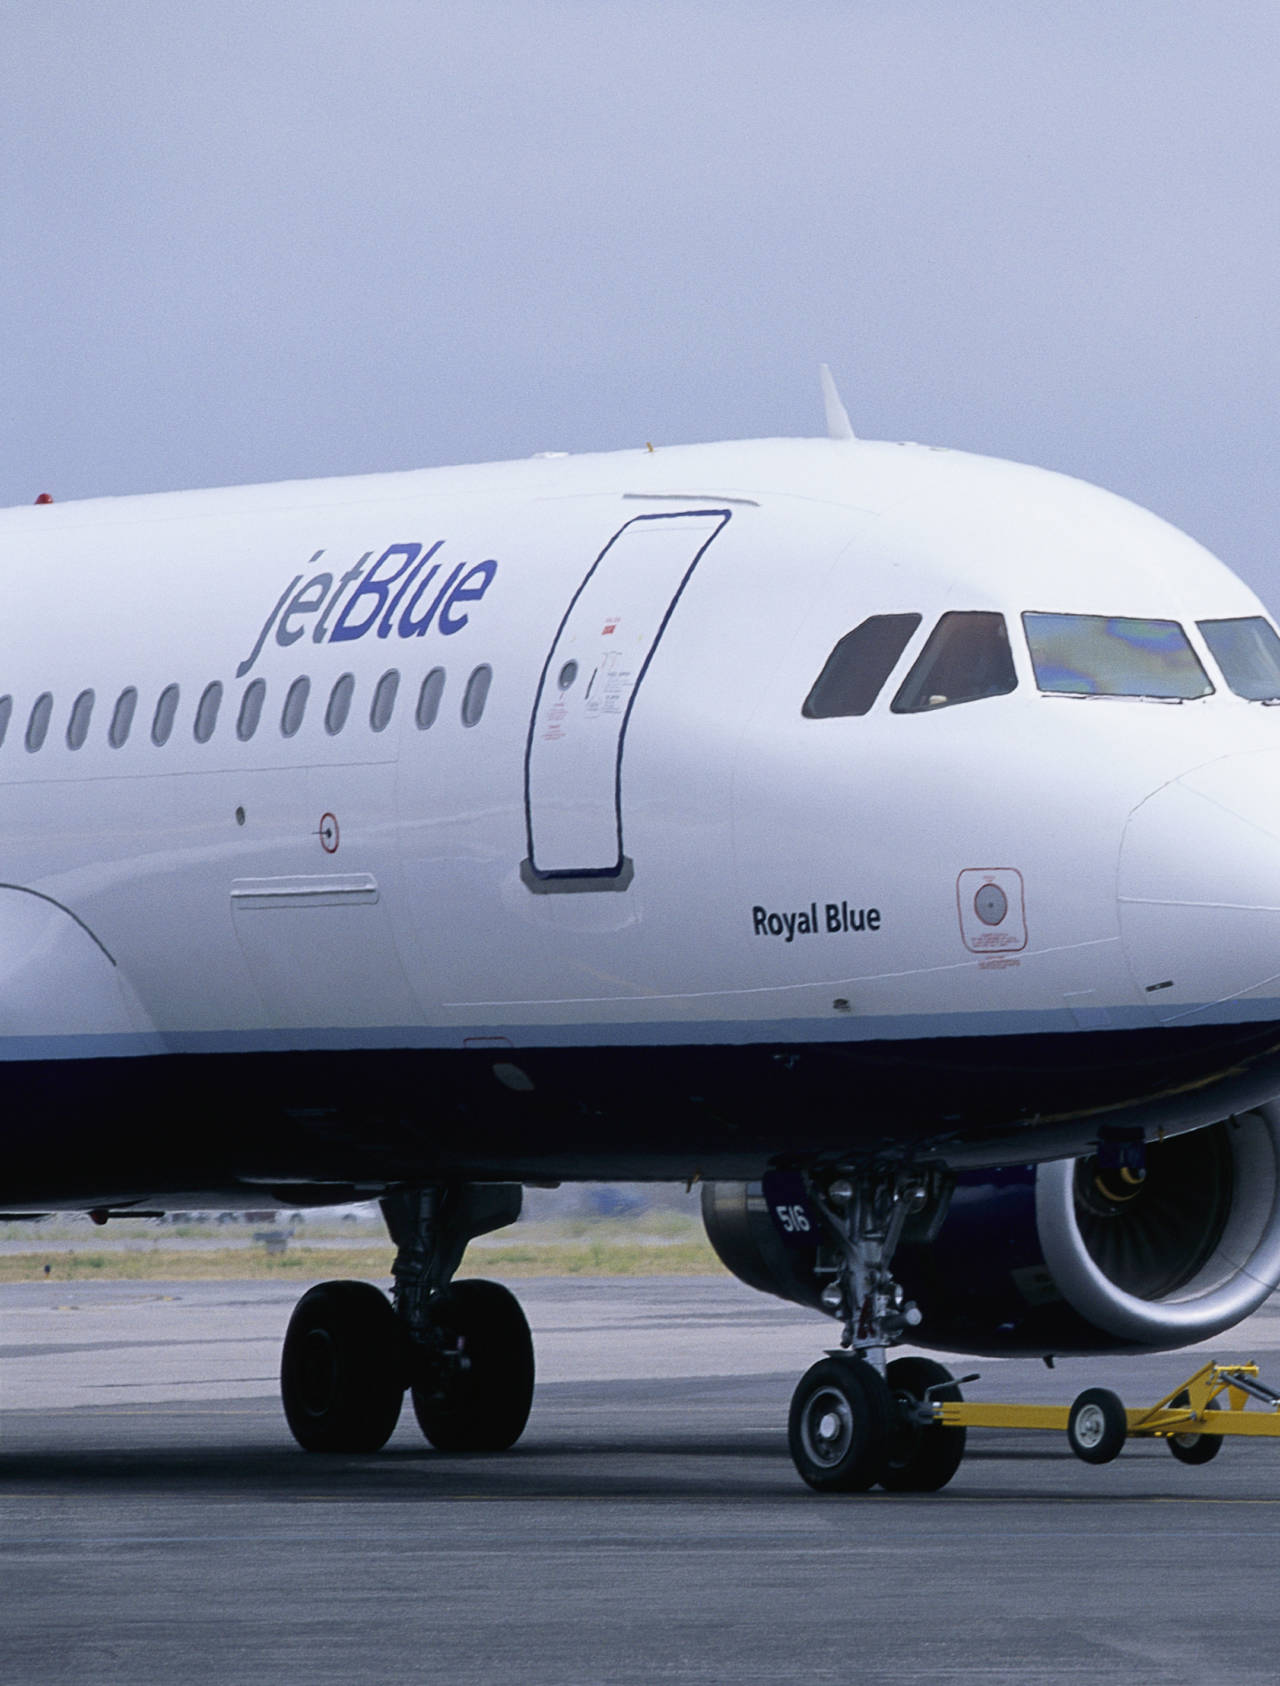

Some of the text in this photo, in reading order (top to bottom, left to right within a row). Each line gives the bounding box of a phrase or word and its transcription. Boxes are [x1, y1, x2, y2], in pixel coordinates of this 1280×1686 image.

[236, 541, 498, 678] jetBlue
[753, 901, 881, 942] Royal Blue
[776, 1204, 811, 1232] 516
